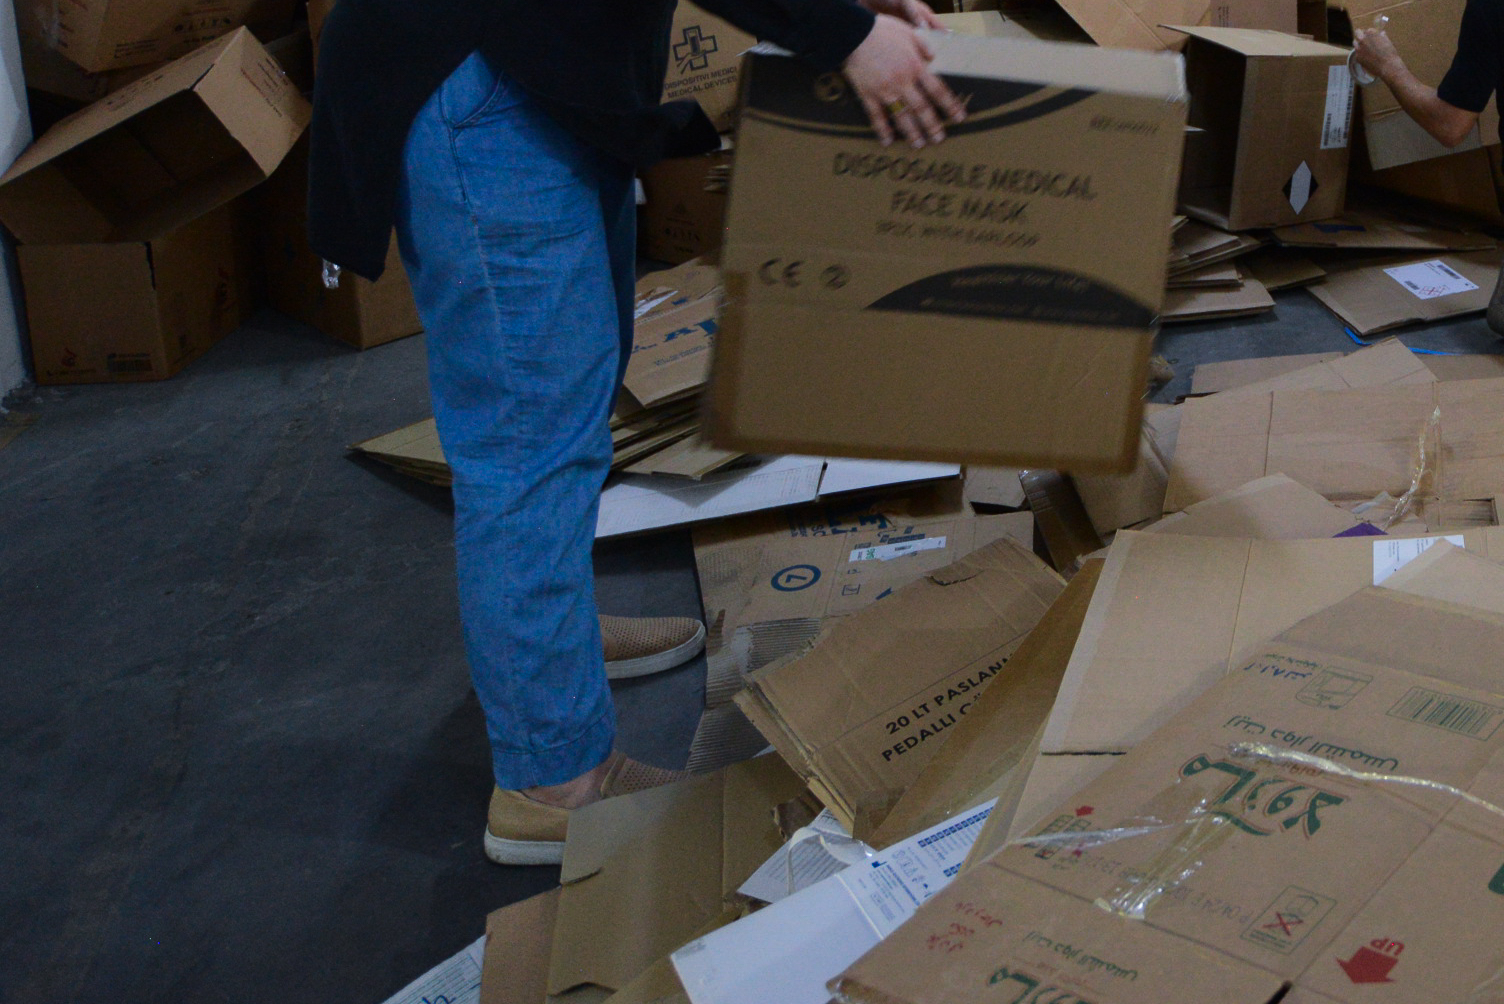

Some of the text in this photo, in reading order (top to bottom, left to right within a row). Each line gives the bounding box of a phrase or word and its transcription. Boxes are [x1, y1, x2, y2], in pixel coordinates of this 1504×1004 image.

[665, 66, 737, 91] DISPOSITIVI MEDICI
[667, 85, 703, 99] MEDICAL
[832, 150, 1099, 202] DISPOSABLE MEDICAL
[890, 188, 1029, 224] FACE MASK
[885, 715, 911, 735] 20
[911, 702, 931, 720] LT
[881, 713, 957, 762] PEDALLI
[1223, 715, 1399, 772] زيت دوار الشمس
[1178, 752, 1350, 841] مازولا
[1369, 937, 1406, 956] UP
